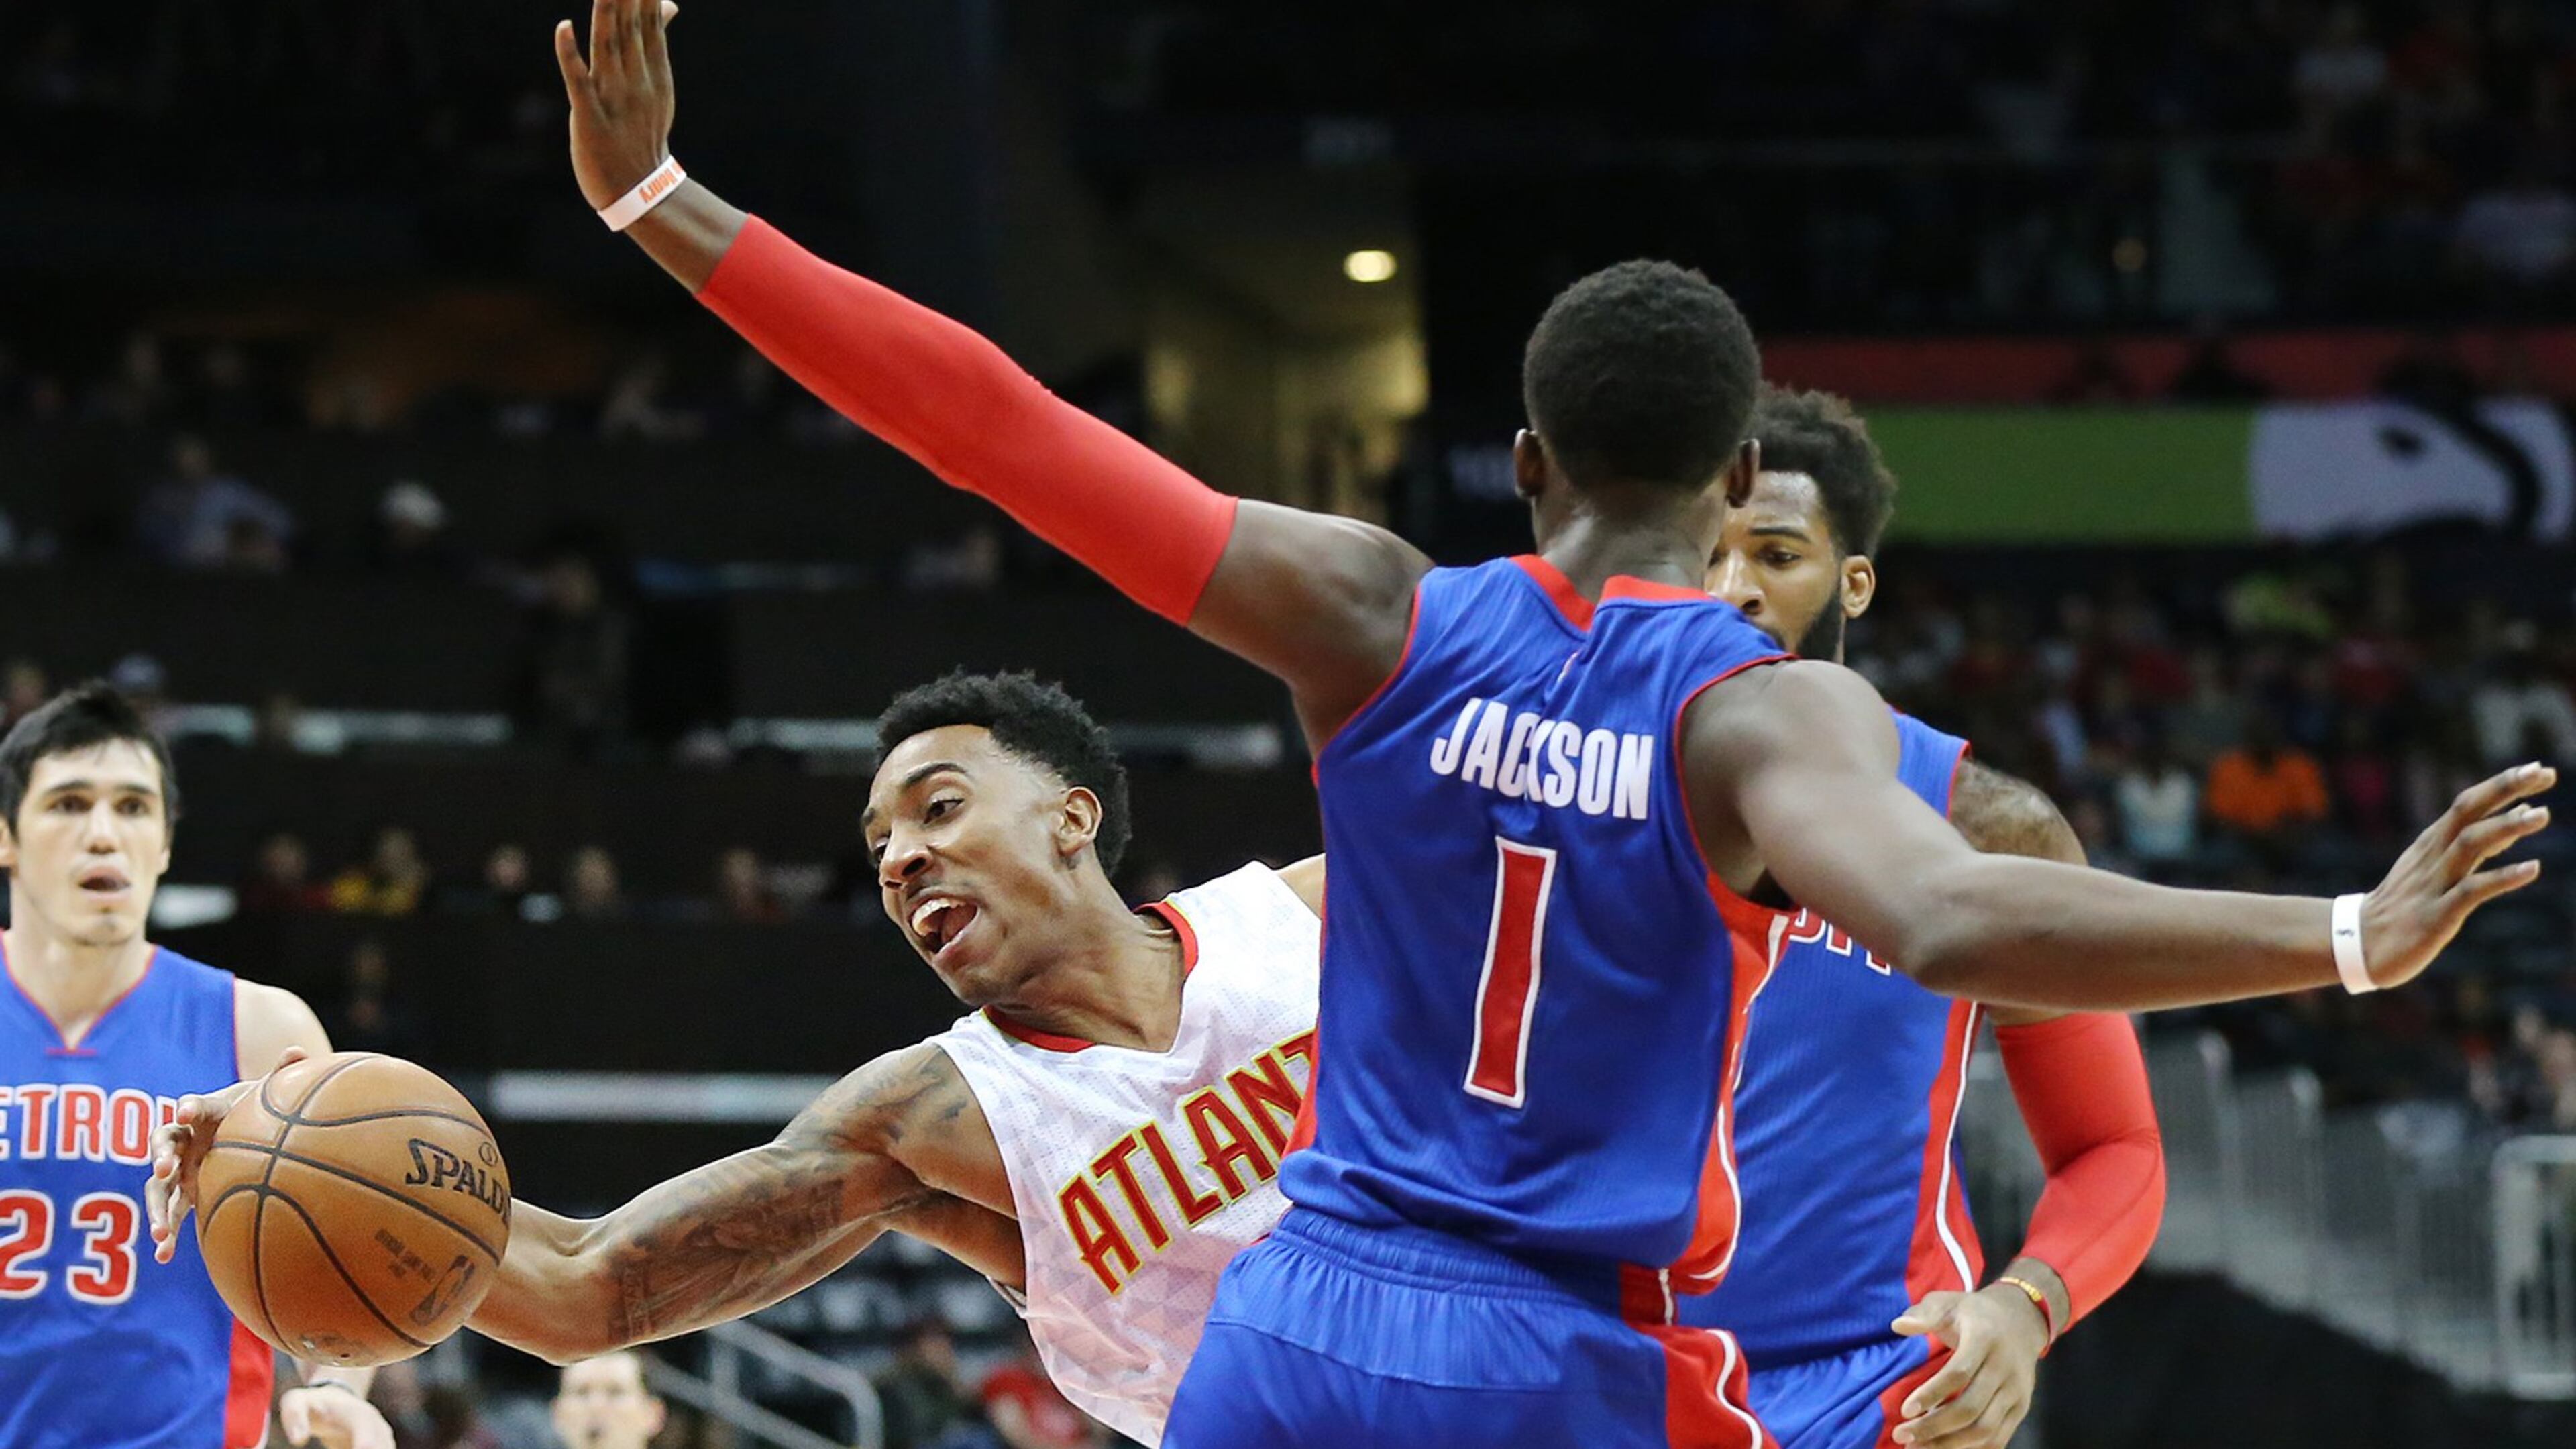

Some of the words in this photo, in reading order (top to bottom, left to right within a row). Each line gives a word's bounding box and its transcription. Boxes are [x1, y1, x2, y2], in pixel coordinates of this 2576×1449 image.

[1462, 835, 1557, 1109] 1
[0, 1189, 140, 1305] 23
[1057, 1027, 1317, 1297] ATLAN
